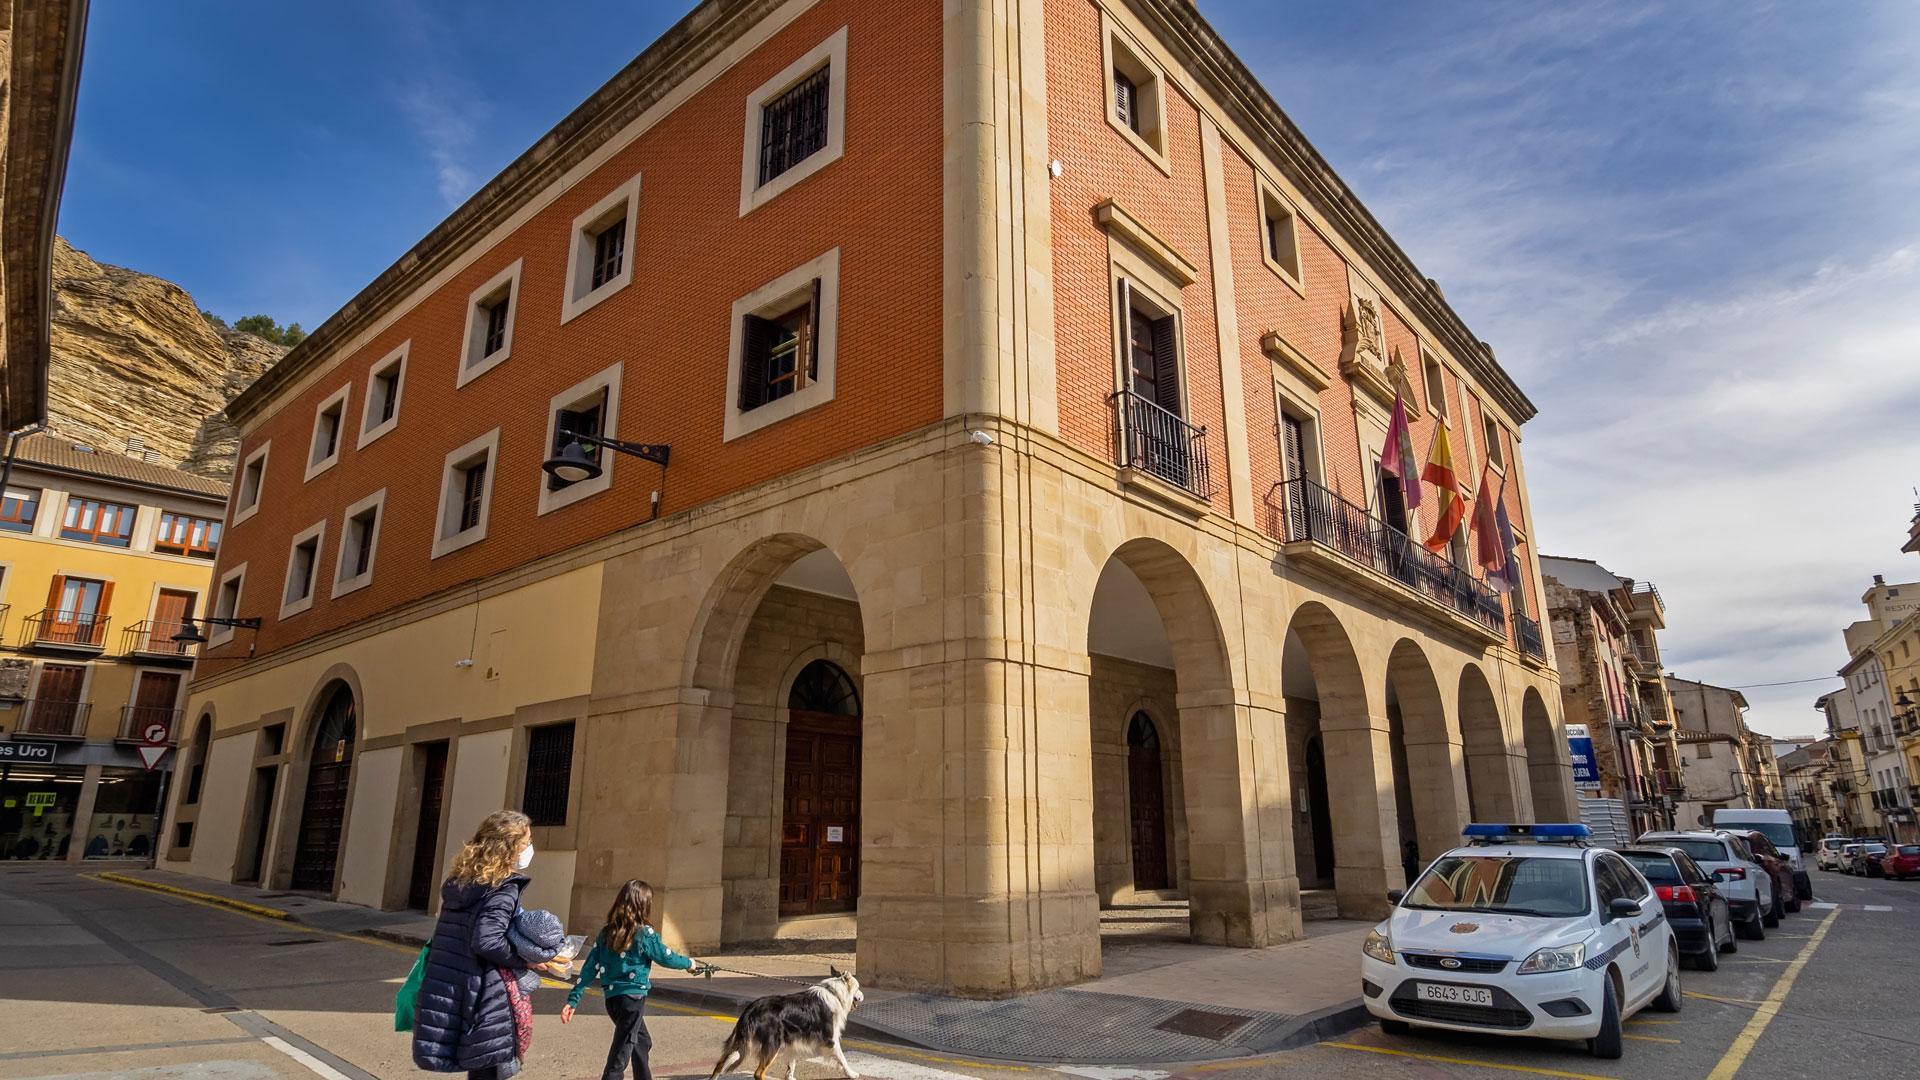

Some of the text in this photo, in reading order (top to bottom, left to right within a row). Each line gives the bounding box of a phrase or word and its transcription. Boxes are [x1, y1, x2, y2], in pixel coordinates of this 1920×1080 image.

[18, 744, 48, 757] Uro
[1427, 985, 1486, 1003] 6643 GJG
